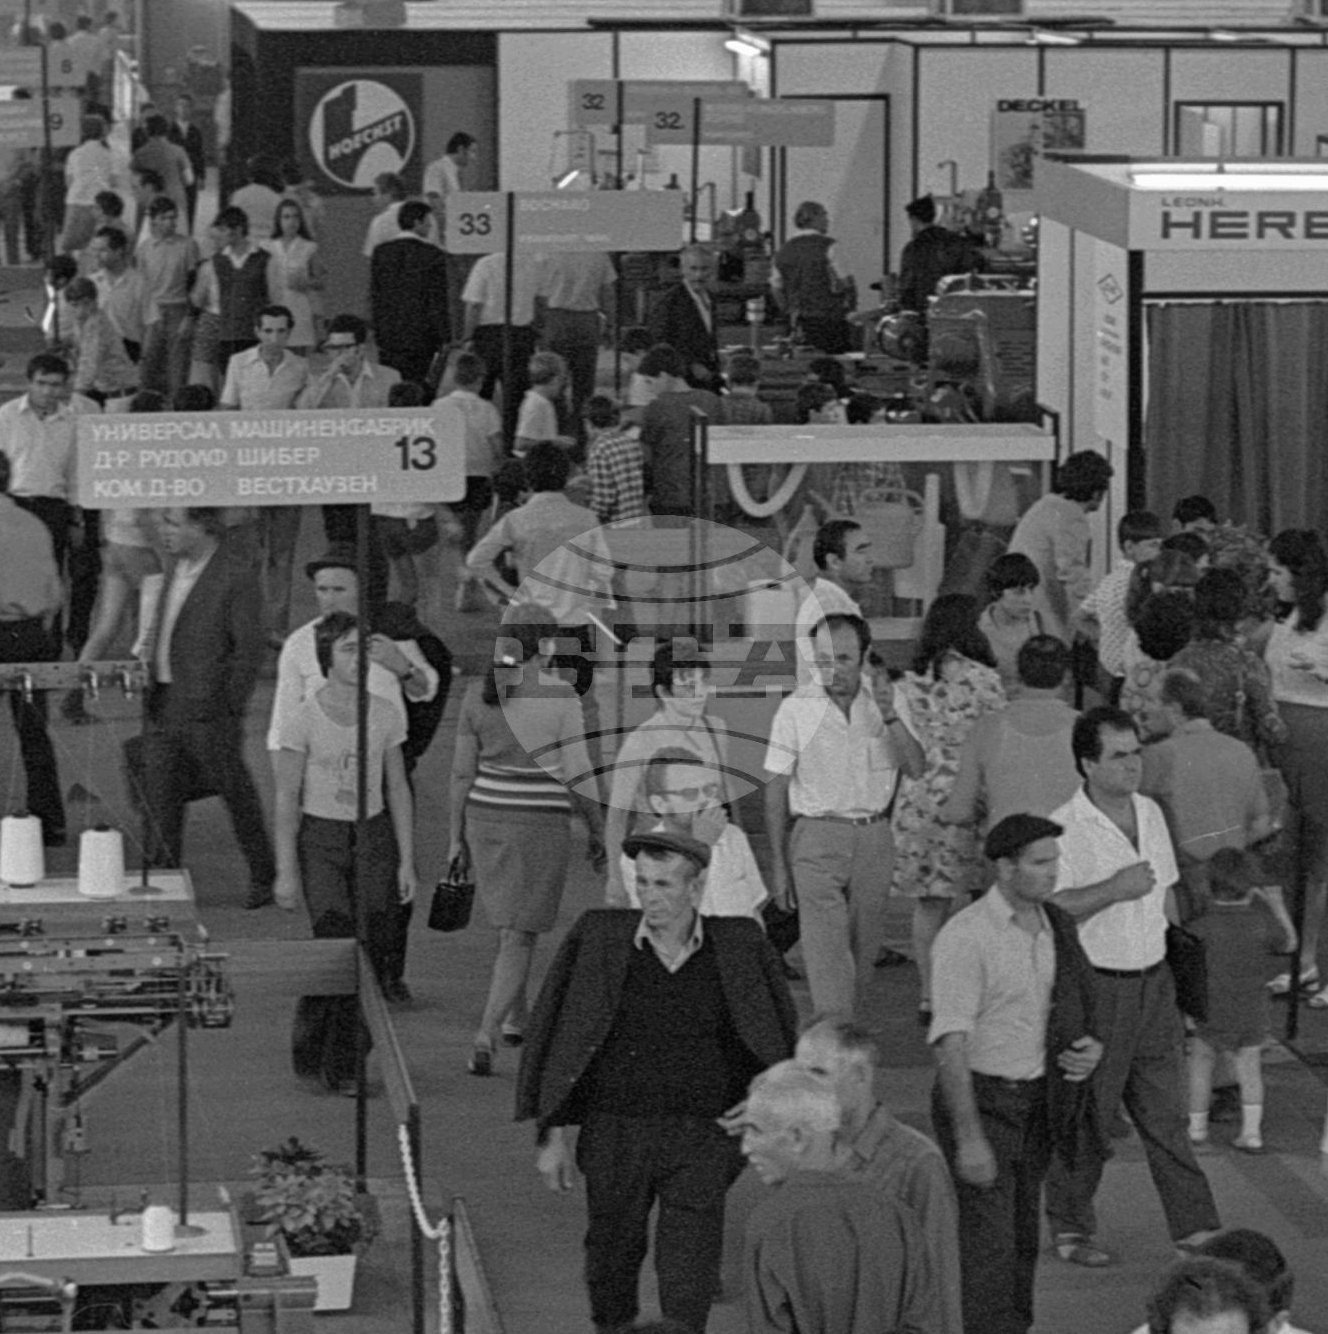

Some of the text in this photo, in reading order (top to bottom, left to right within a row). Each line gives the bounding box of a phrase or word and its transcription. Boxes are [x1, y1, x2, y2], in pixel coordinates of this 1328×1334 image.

[582, 93, 606, 111] 32
[997, 99, 1084, 113] DECKEL
[328, 114, 404, 161] HOECHST
[459, 213, 492, 236] 33
[92, 417, 436, 442] УНИВЕРСАЛ МАШИНЕНФАБРИК
[139, 447, 228, 469] РУДОЛФ
[237, 447, 320, 467] ШИБЕР
[395, 435, 438, 471] 13
[237, 475, 378, 496] ВЕСТХАУЗЕН
